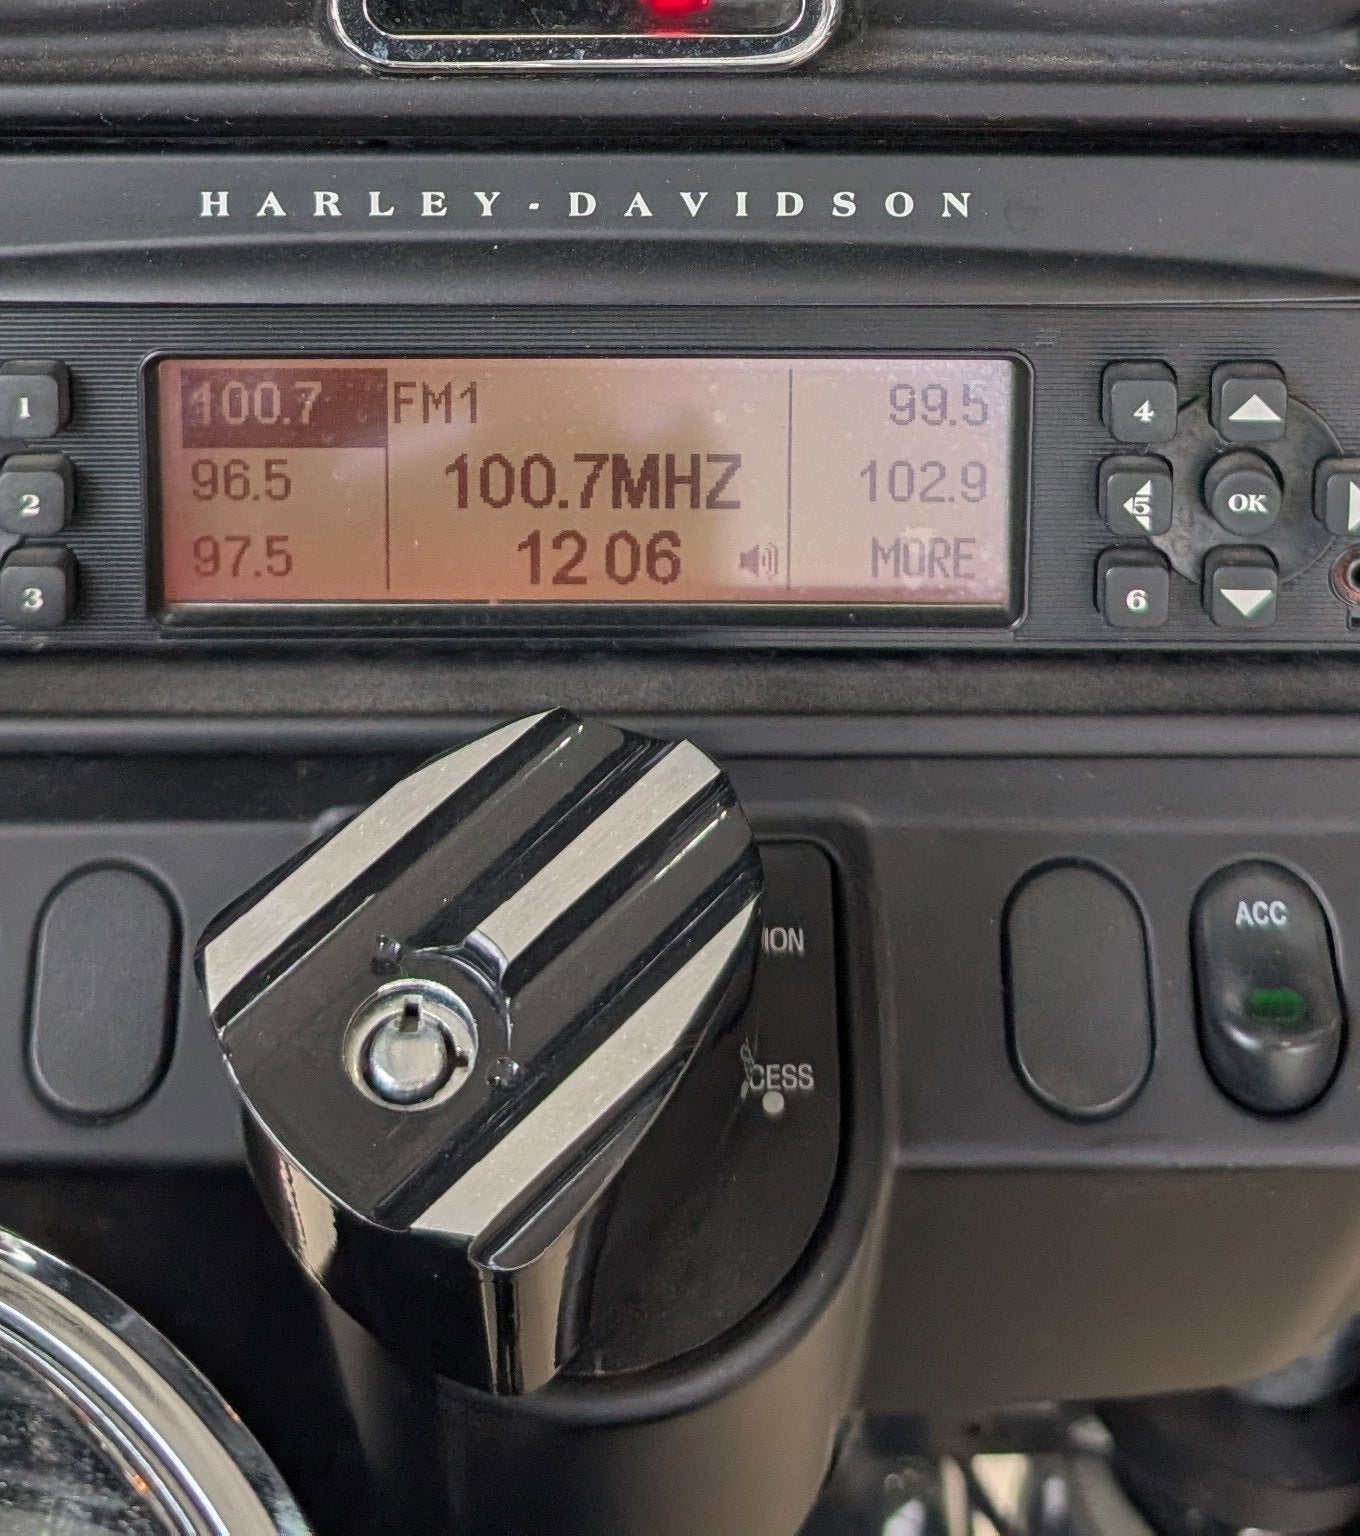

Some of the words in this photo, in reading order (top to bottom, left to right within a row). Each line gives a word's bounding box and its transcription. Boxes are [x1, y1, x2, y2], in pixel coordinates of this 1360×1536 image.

[199, 190, 972, 219] HARLEY-DAVIDSON
[17, 397, 31, 419] 1
[191, 380, 322, 425] 100.7
[394, 381, 477, 424] FM1
[890, 383, 988, 426] 99.5
[1134, 400, 1154, 423] 4
[191, 458, 291, 501] 96.5
[445, 452, 742, 509] 100.7MHZ
[859, 459, 988, 503] 102.9
[20, 494, 41, 516] 2
[1228, 492, 1269, 514] OK
[193, 535, 293, 577] 97.5
[871, 536, 976, 579] MORE
[22, 588, 44, 612] 3
[1126, 589, 1148, 613] 6
[1235, 900, 1288, 927] ACC
[746, 1064, 815, 1091] CESS
